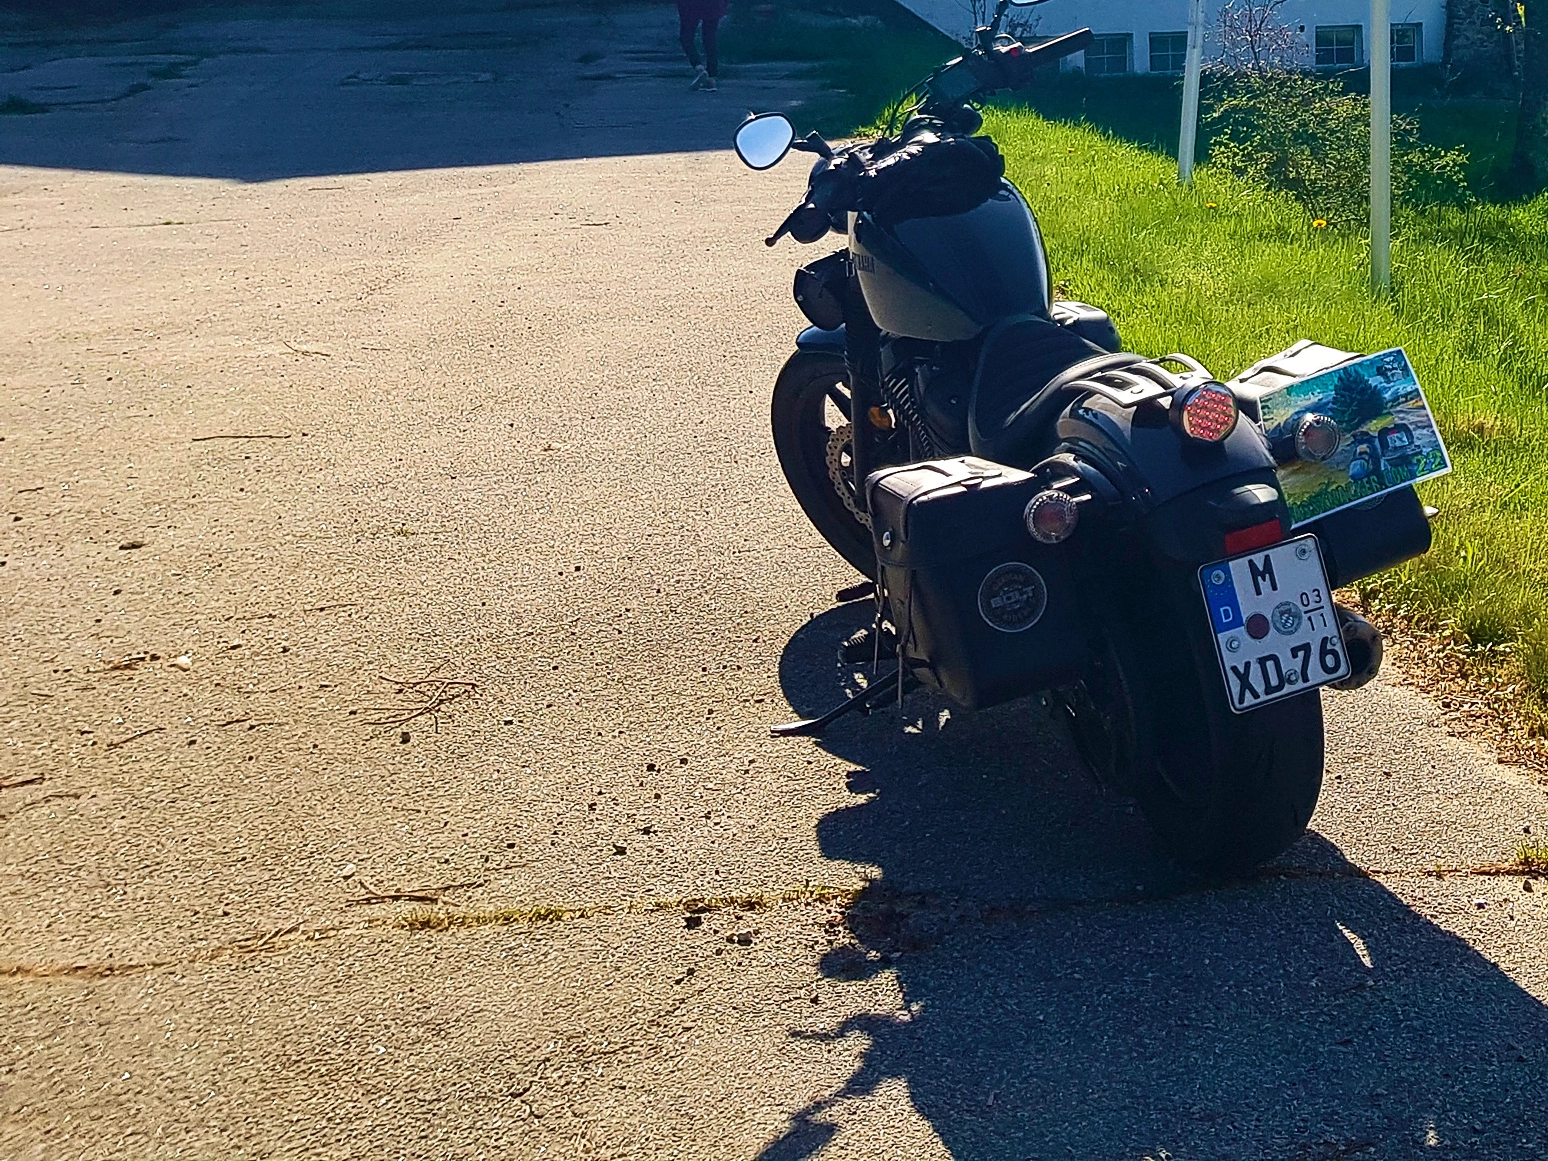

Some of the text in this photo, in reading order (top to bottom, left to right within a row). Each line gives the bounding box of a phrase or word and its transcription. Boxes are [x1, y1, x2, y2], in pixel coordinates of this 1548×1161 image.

[1413, 448, 1446, 476] 22
[1248, 554, 1279, 596] M
[1300, 588, 1322, 607] 03
[1220, 605, 1233, 623] D
[1307, 613, 1328, 631] 11
[1230, 636, 1342, 705] XD 76
